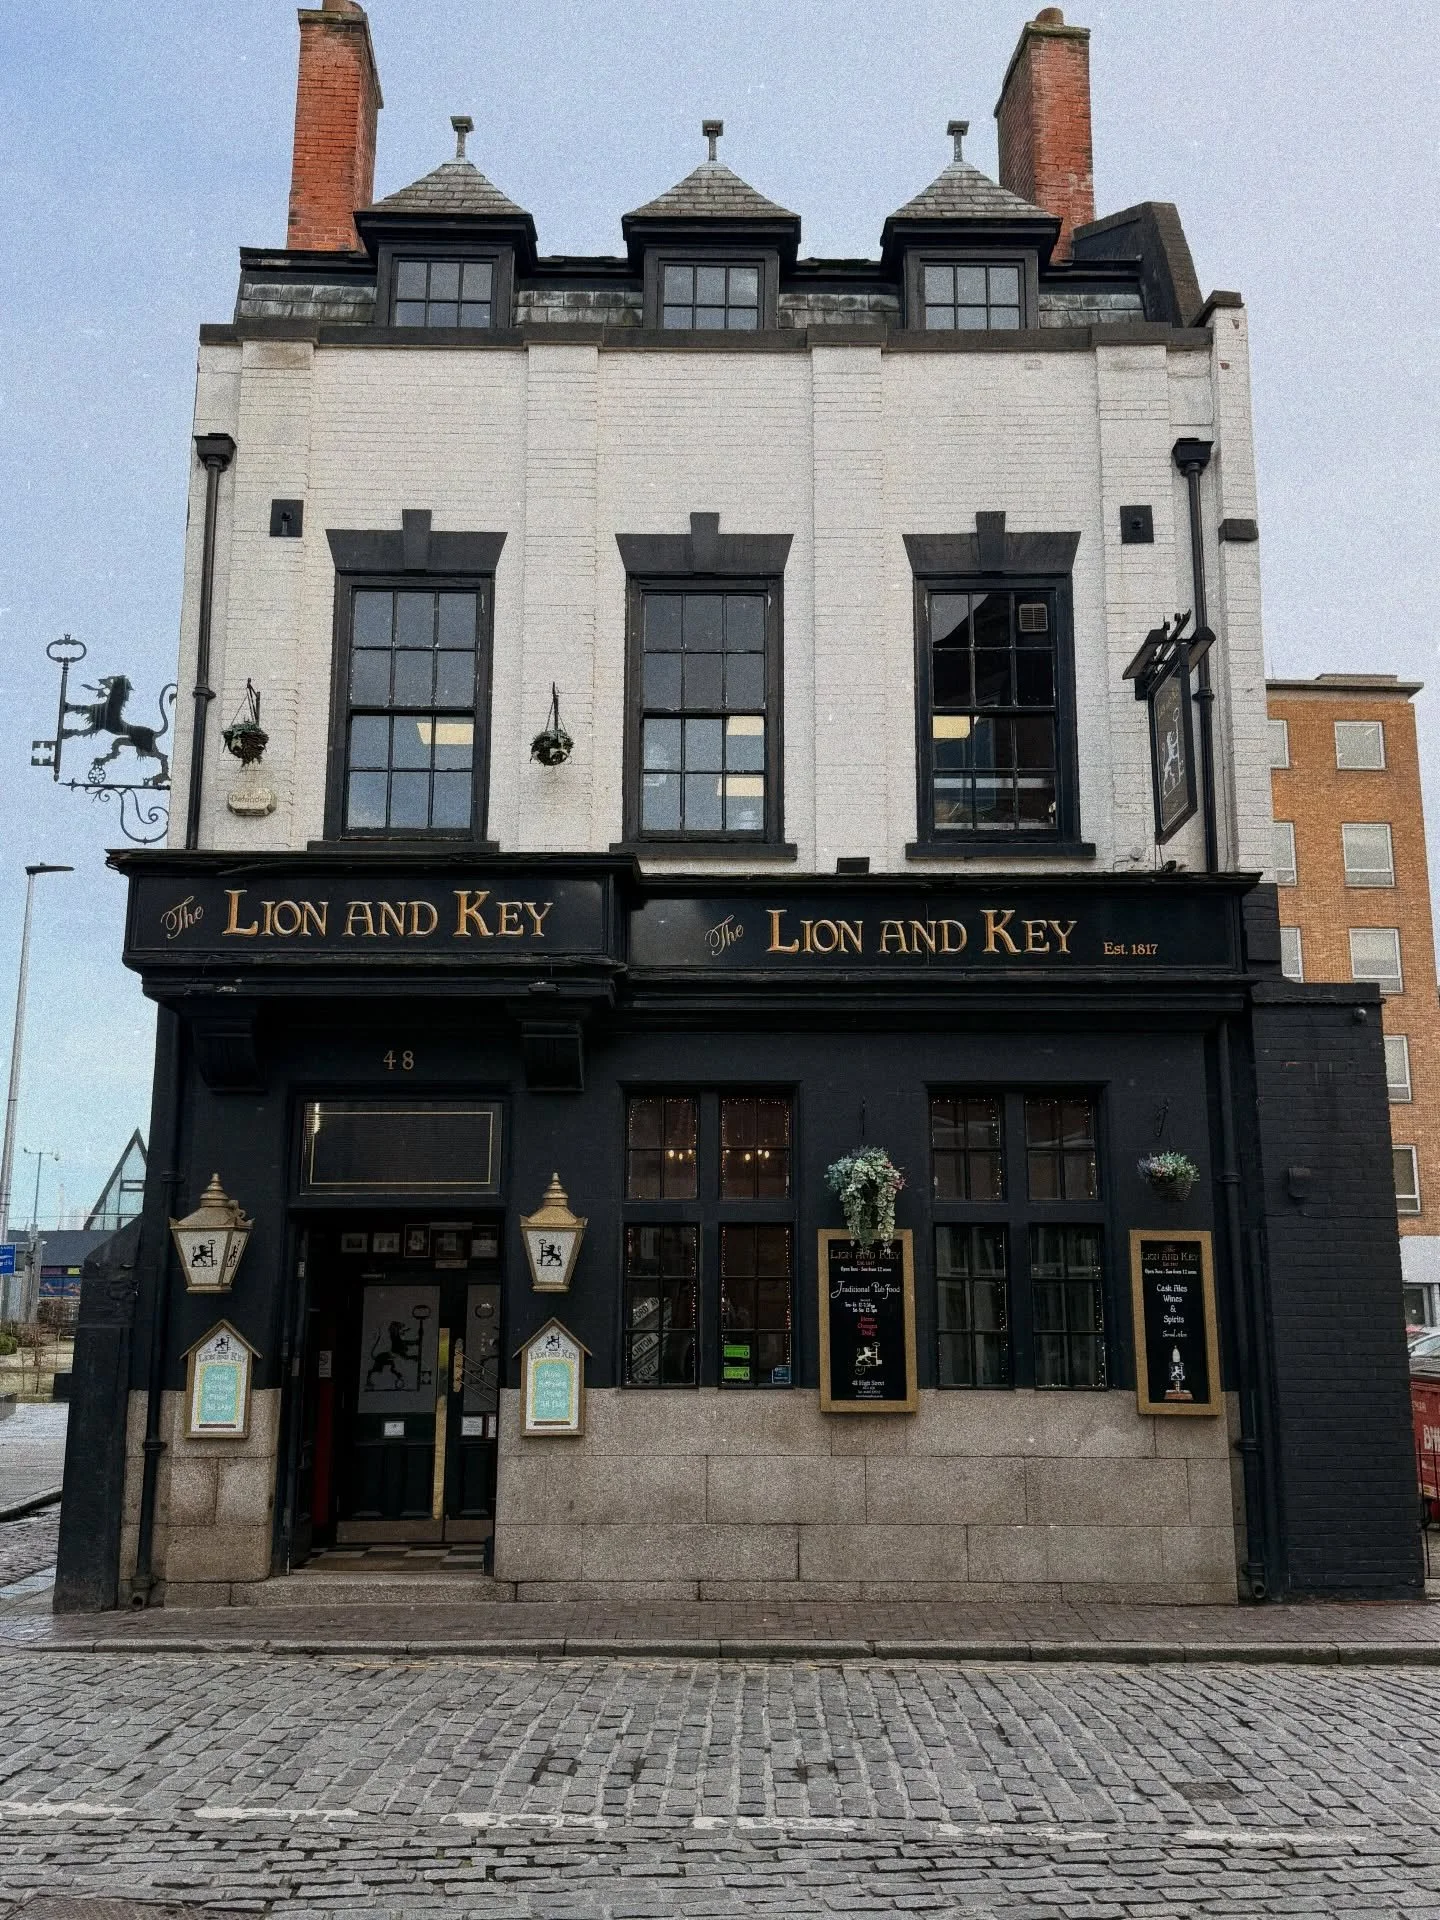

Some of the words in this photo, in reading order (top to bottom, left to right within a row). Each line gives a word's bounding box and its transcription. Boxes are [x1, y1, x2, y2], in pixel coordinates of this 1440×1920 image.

[161, 894, 204, 940] The
[222, 889, 330, 937] LION
[344, 901, 438, 937] AND
[452, 889, 555, 938] KEY
[704, 914, 745, 956] The
[766, 909, 864, 955] LION
[879, 918, 969, 955] AND
[980, 909, 1078, 955] KEY
[1104, 942, 1128, 956] Est.
[1131, 942, 1159, 956] 1817
[383, 1051, 414, 1071] 48
[830, 1280, 870, 1299] Traditional
[871, 1281, 885, 1293] Pub
[1156, 1283, 1173, 1292] Cask
[1163, 1294, 1183, 1303] Wines
[1170, 1304, 1177, 1313] &
[1163, 1315, 1185, 1325] Spirits
